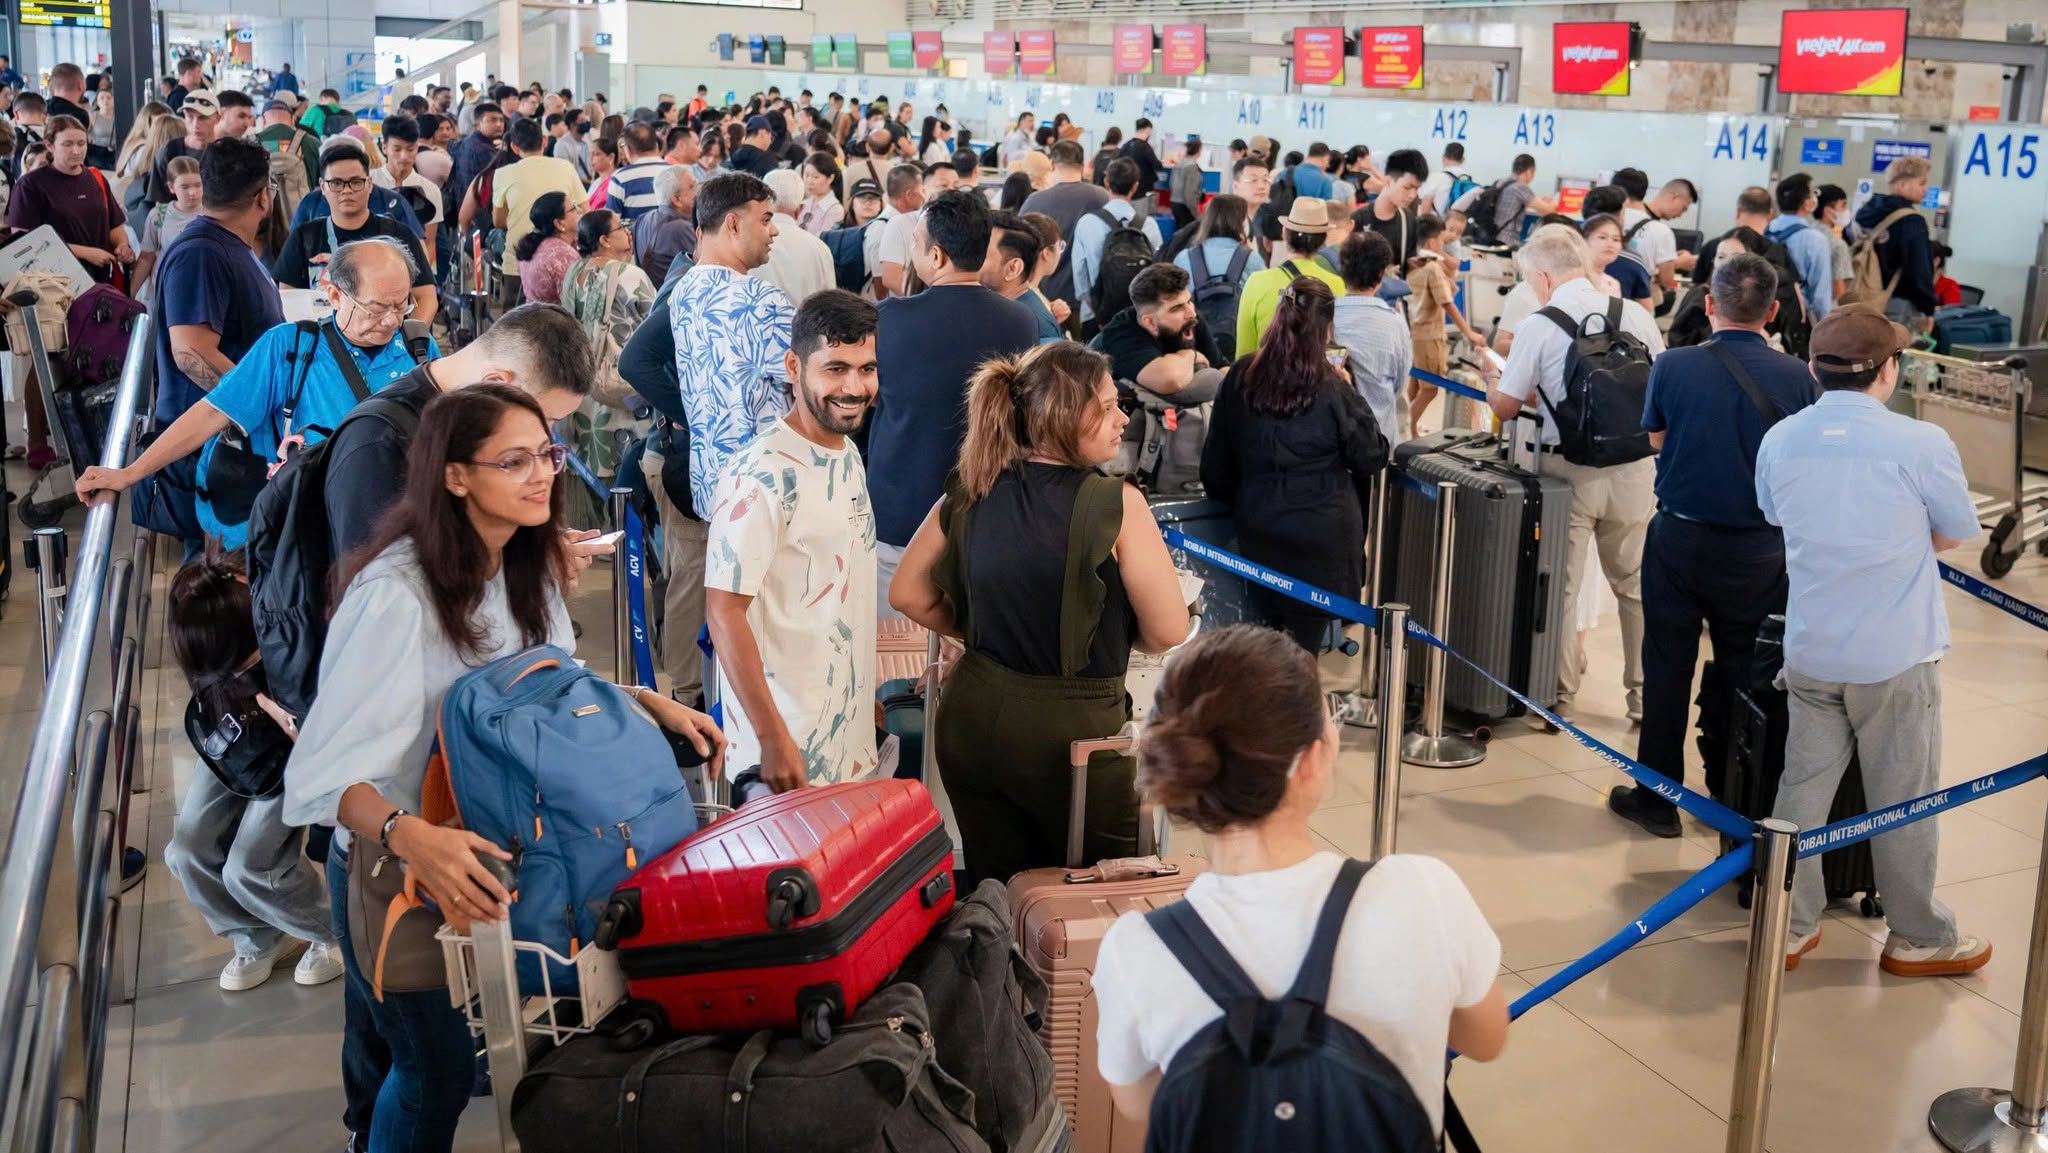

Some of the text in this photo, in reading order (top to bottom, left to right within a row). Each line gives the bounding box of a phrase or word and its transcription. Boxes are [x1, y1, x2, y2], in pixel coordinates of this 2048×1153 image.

[1238, 99, 1260, 125] A10
[1298, 102, 1324, 128] A11
[1432, 109, 1468, 139] A12
[1514, 113, 1554, 146] A13
[1713, 122, 1768, 160] A14
[1964, 133, 2039, 179] A15
[1207, 549, 1260, 577] INTERNATIONAL
[1261, 571, 1293, 591] AIRPORT
[1972, 776, 1996, 793] N.I.A
[1829, 808, 1908, 843] INTERNATIONAL
[1909, 791, 1950, 816] AIRPORT
